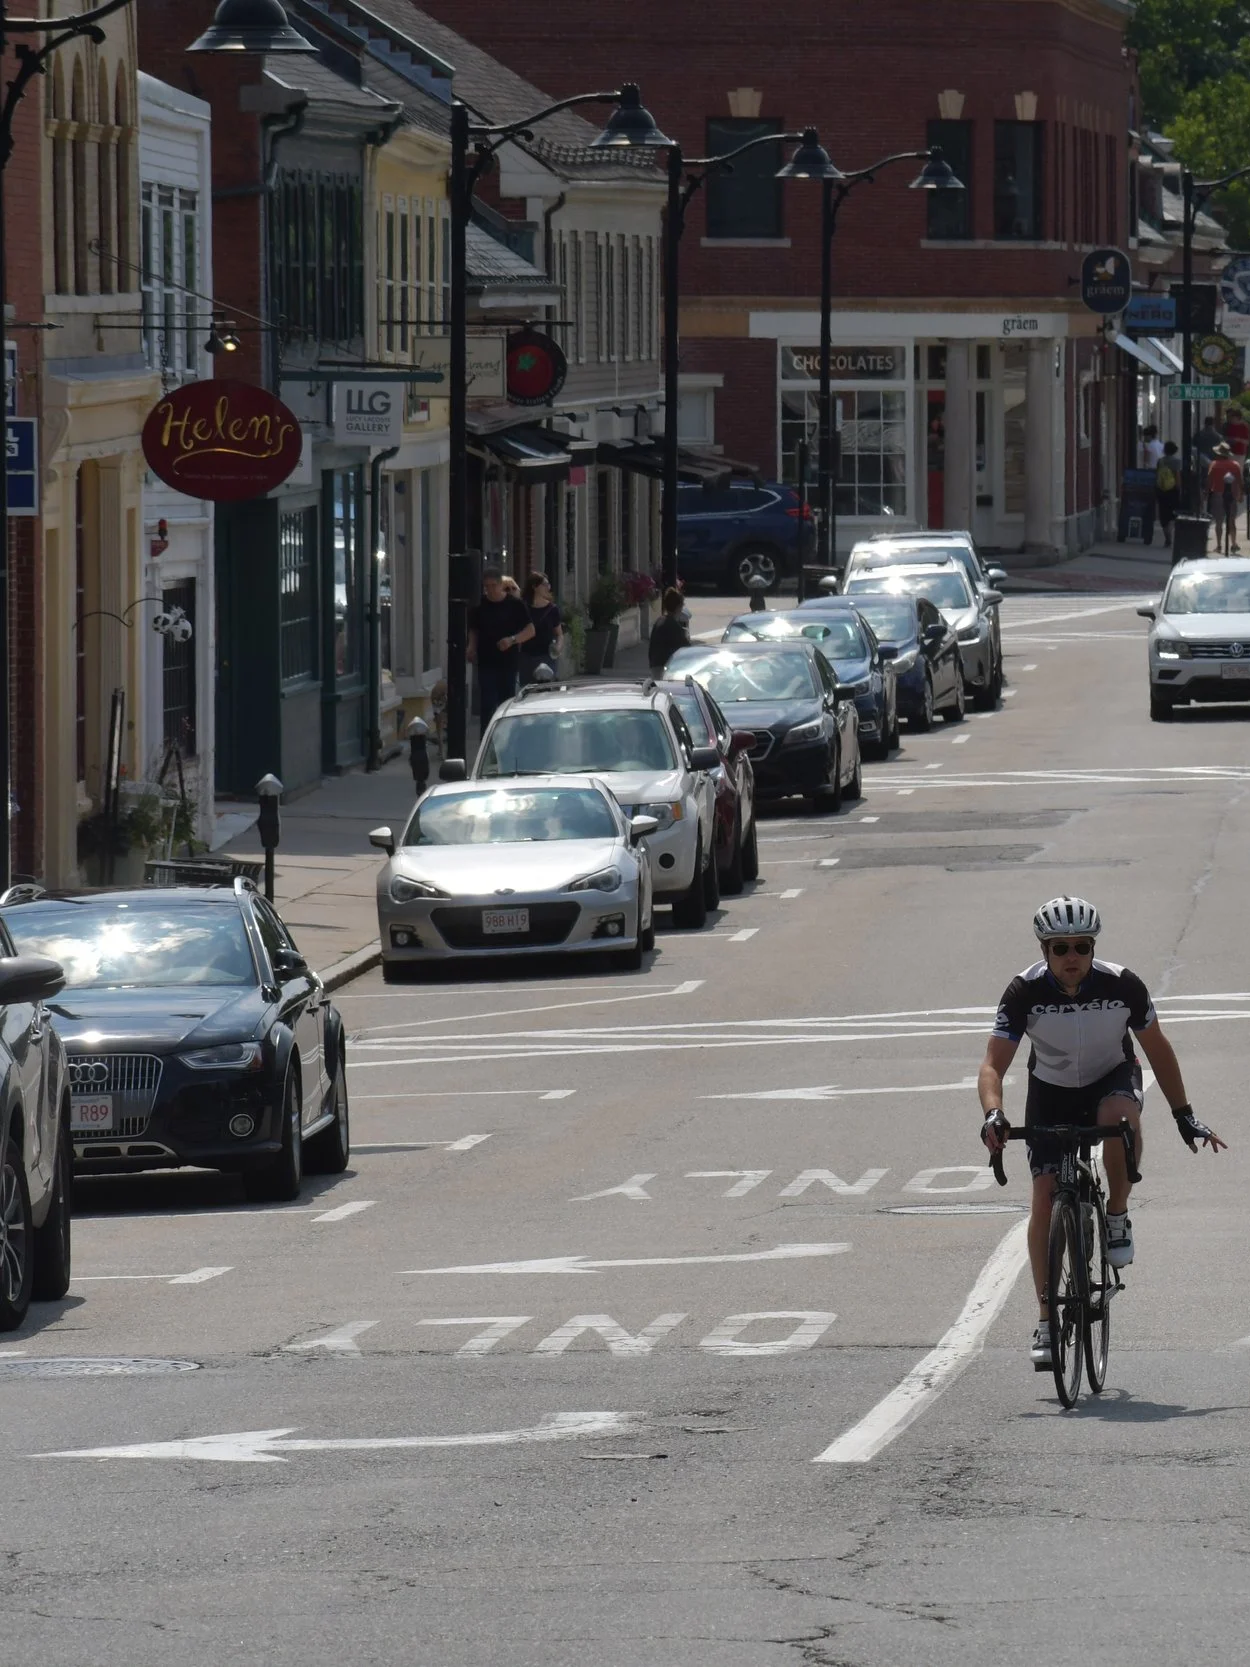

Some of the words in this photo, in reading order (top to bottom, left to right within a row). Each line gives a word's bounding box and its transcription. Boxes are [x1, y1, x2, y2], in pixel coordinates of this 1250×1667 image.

[346, 389, 391, 415] LLG
[1184, 386, 1214, 398] Walden
[157, 395, 296, 458] Helen's
[346, 422, 391, 432] GALLERY
[1031, 998, 1125, 1015] cervélo
[80, 1104, 108, 1121] R89
[568, 1165, 997, 1201] ONLY
[283, 1311, 838, 1358] ONLY
